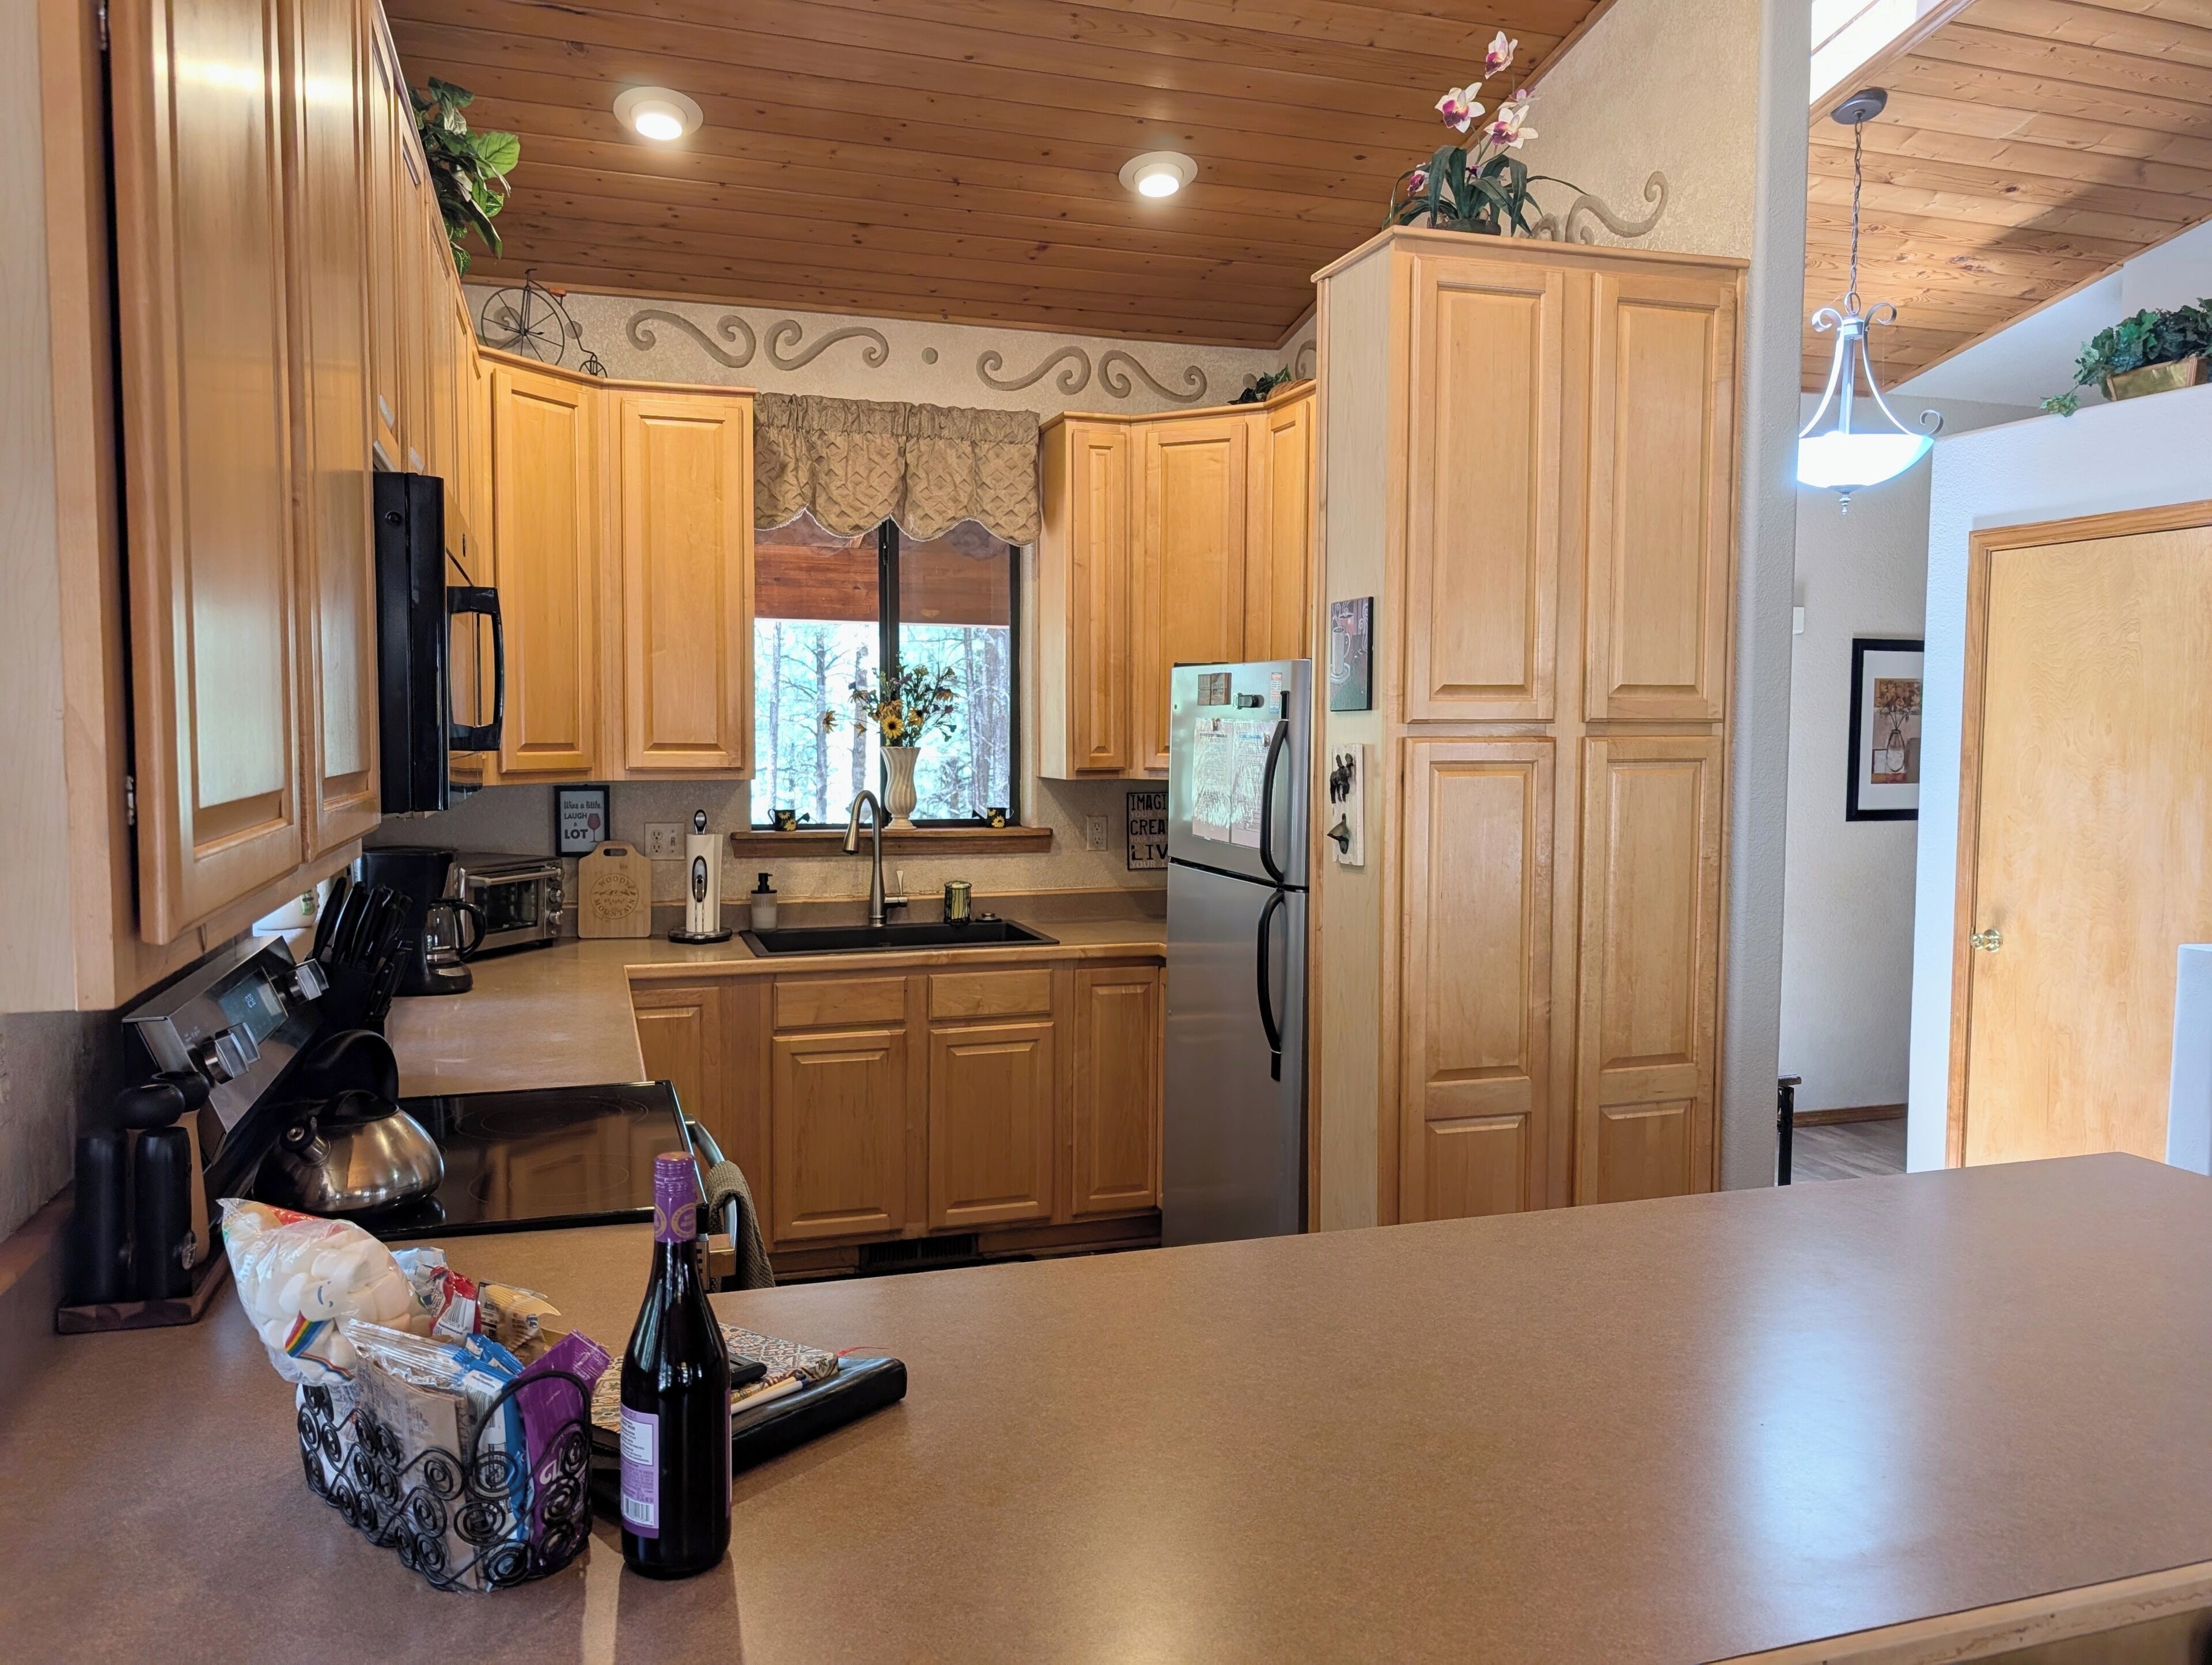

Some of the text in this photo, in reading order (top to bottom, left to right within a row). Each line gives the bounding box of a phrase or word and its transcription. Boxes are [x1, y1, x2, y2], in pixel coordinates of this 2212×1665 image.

[1131, 794, 1166, 810] IMAGI
[1130, 810, 1153, 818] YOUR
[565, 829, 588, 839] LOT
[1130, 819, 1168, 835] CREA
[1131, 835, 1147, 843] YOUR
[1131, 844, 1168, 860] LIV
[594, 898, 635, 917] MOUNTAIN
